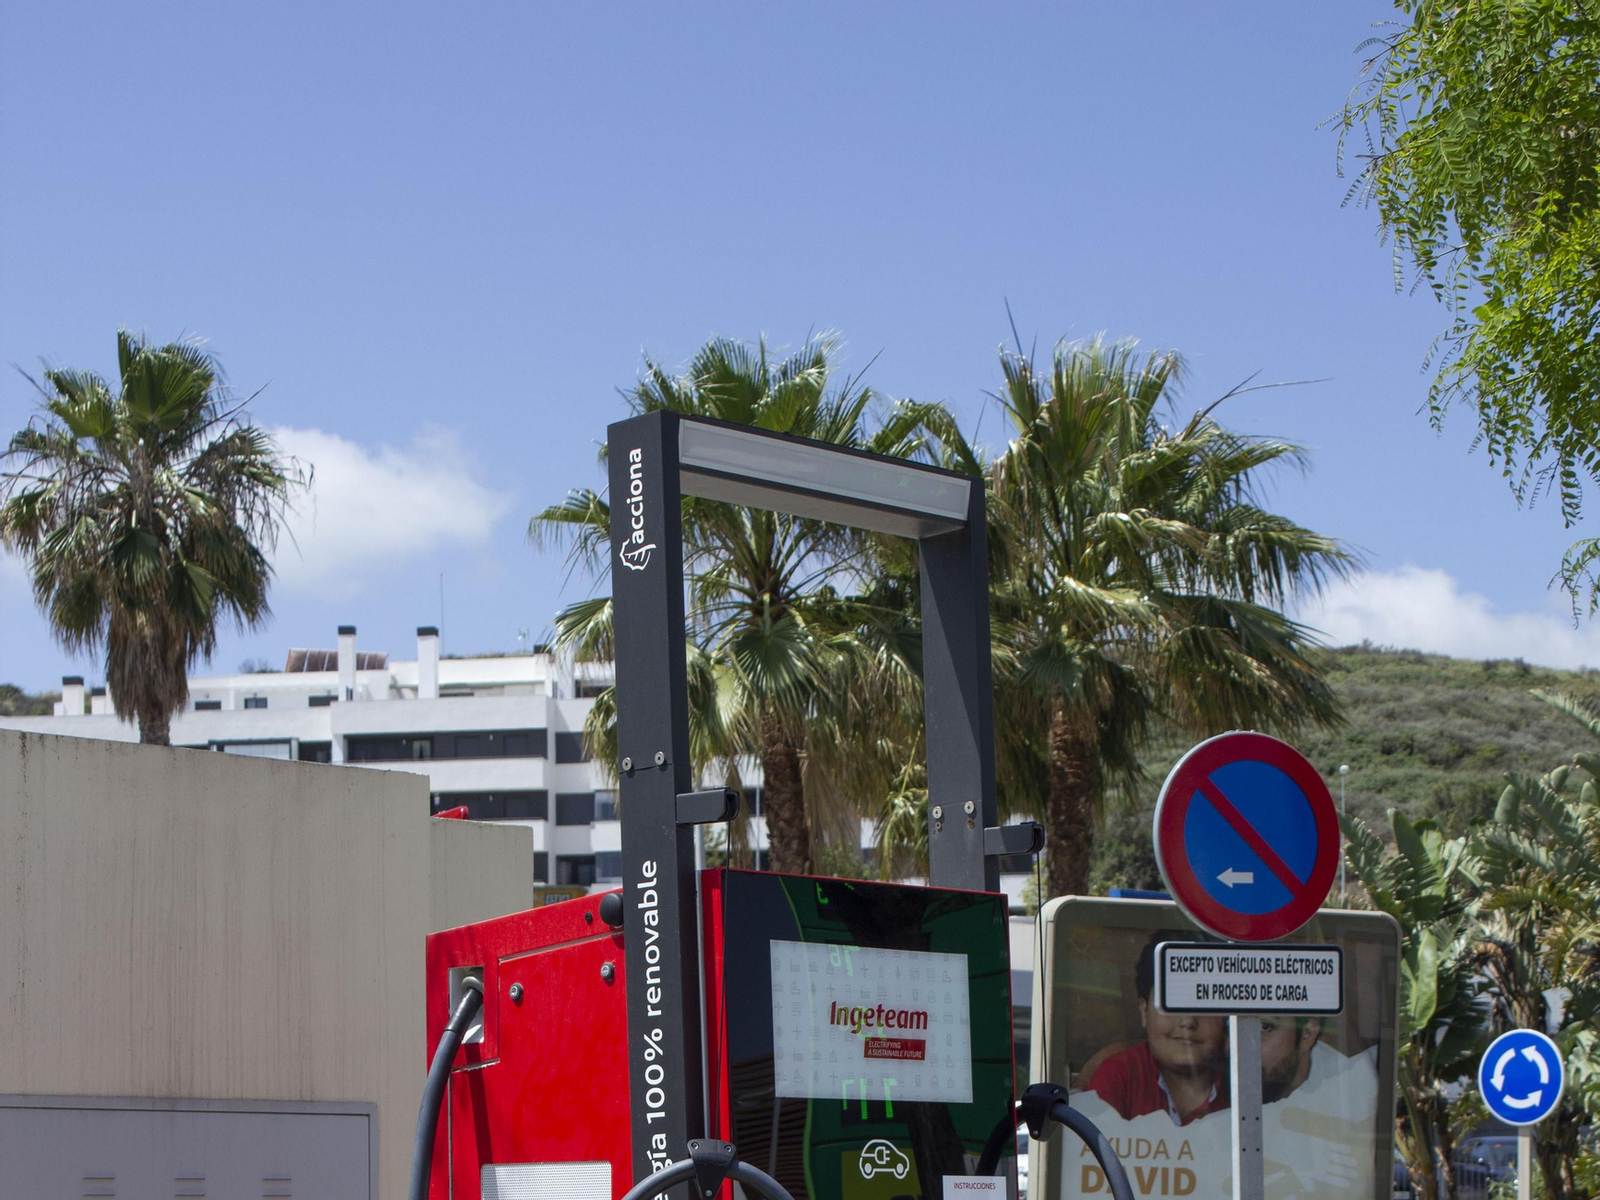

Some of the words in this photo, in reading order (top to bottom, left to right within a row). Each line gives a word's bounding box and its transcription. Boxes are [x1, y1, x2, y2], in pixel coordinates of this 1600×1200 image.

[626, 447, 645, 544] acciona
[637, 860, 662, 1016] renovable
[1170, 956, 1214, 973] EXCEPTO
[1217, 953, 1272, 974] VEHÍCULOS
[1274, 954, 1334, 975] ELÉCTRICOS
[1196, 983, 1210, 1000] EN
[1212, 984, 1257, 1000] PROCESO
[1260, 984, 1273, 1001] DE
[1275, 985, 1308, 1001] CARGA
[830, 1001, 928, 1034] Ingeteam
[903, 1050, 922, 1058] FUTURE
[643, 1027, 666, 1124] 100%
[1177, 1139, 1194, 1160] A
[1081, 1165, 1197, 1196] DVID
